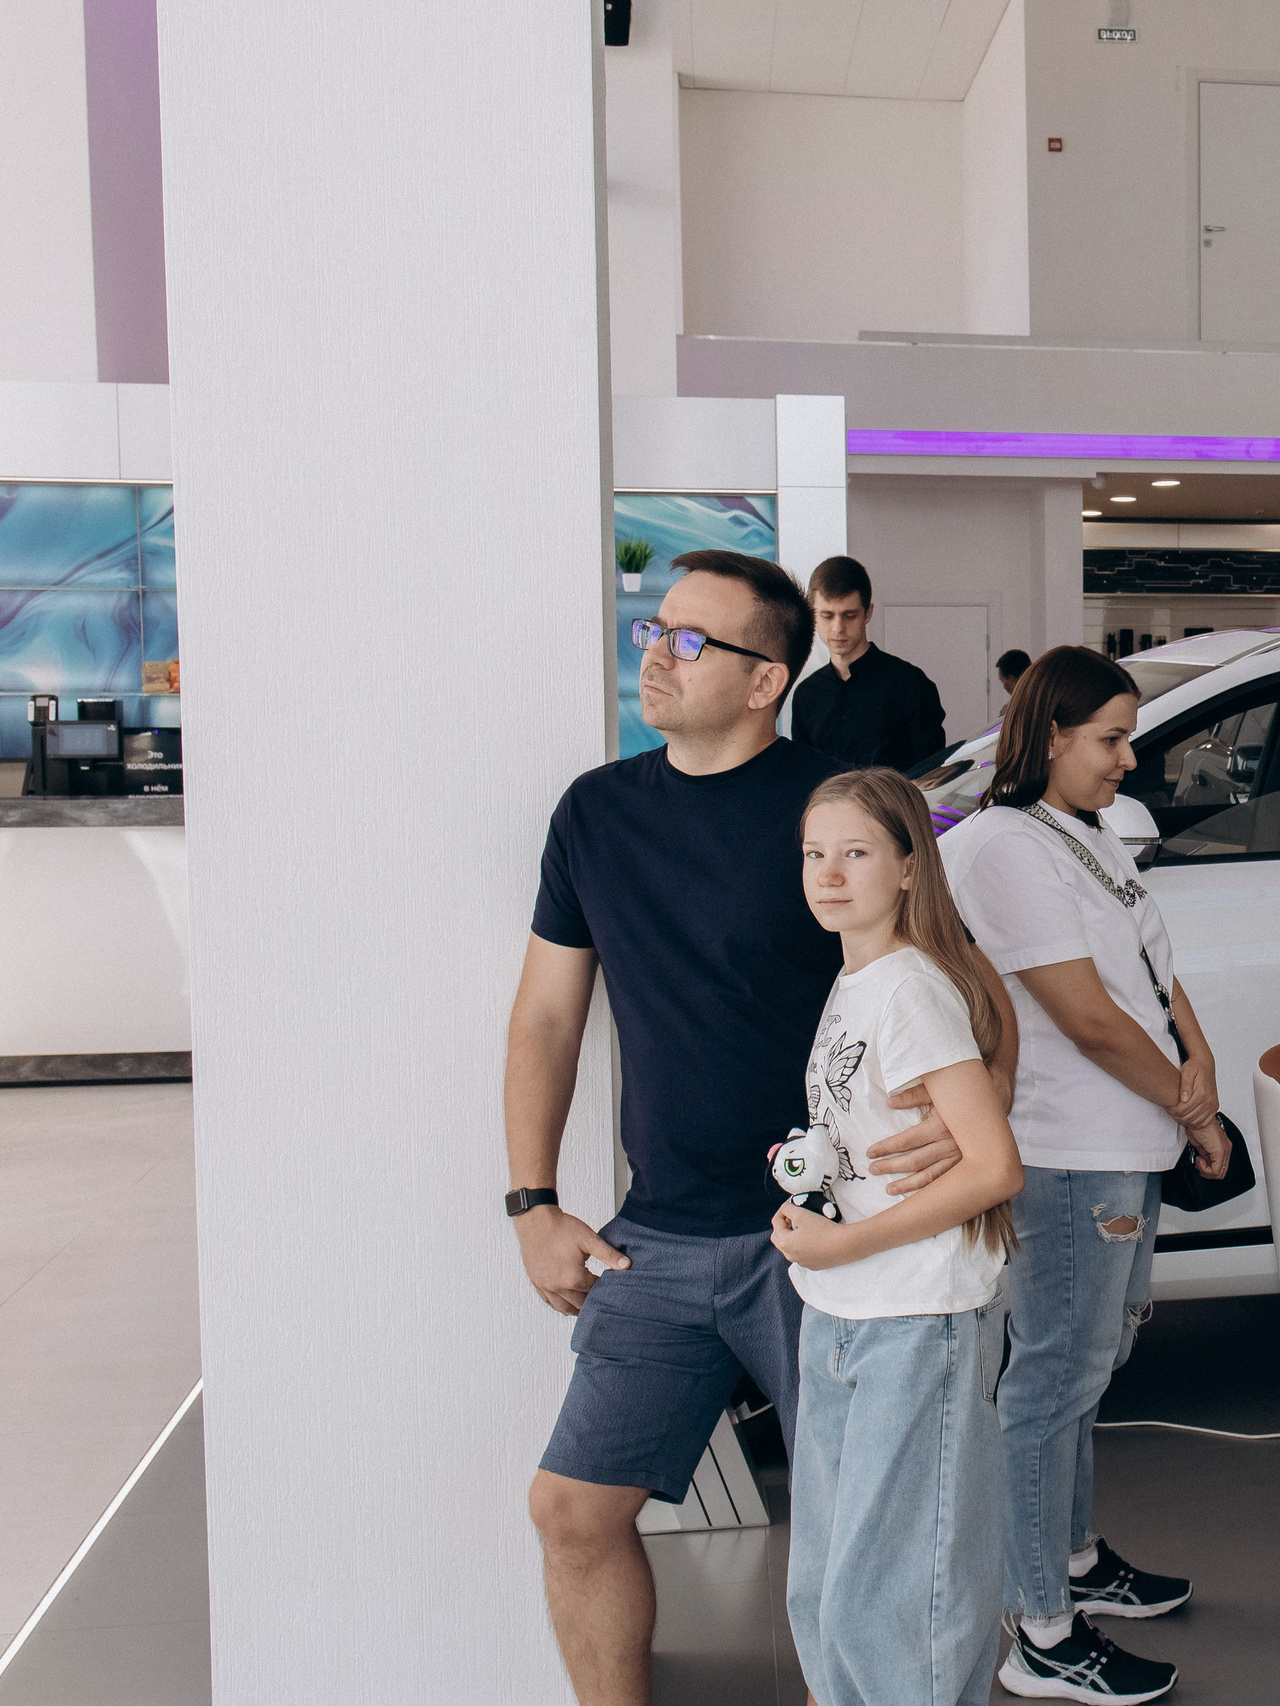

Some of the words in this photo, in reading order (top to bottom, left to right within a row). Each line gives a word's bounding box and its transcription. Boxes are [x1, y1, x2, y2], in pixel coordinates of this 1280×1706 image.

[1100, 30, 1134, 39] ВЫХОД
[147, 750, 164, 759] Это
[151, 784, 169, 792] нём
